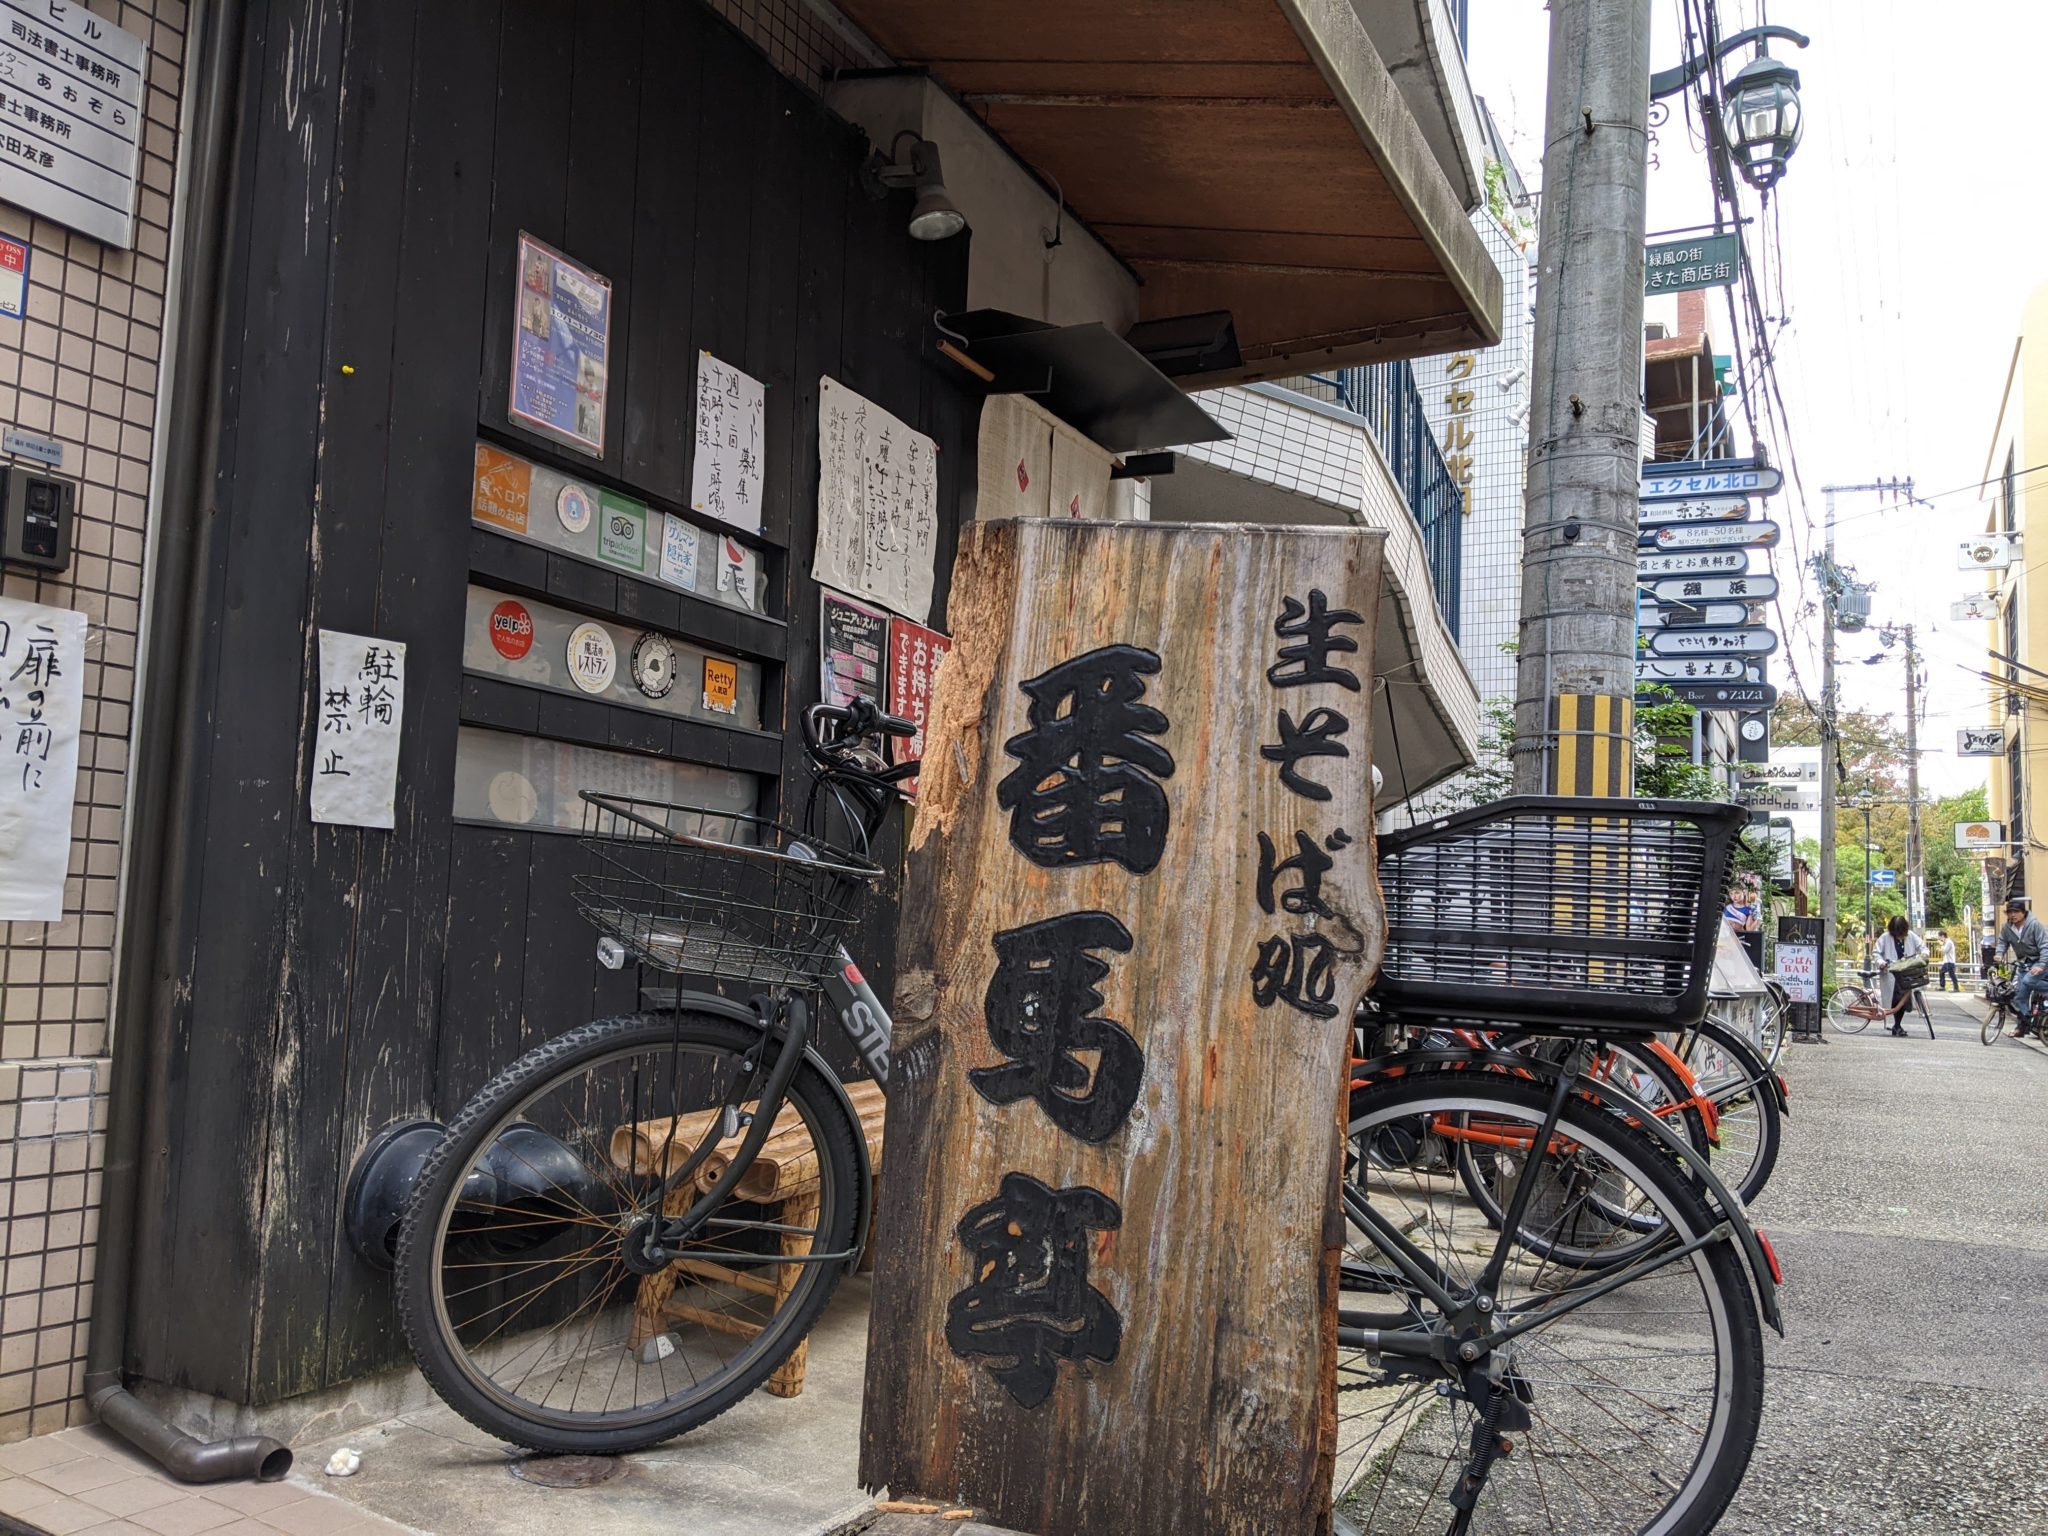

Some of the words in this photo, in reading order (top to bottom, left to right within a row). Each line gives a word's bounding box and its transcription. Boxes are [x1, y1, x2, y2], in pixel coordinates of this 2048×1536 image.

[11, 20, 121, 89] 司法書士事務所
[37, 72, 126, 126] あおぞら
[1649, 247, 1703, 267] 緑風の街
[1644, 262, 1731, 288] きた商店街
[736, 447, 752, 505] 募集
[1649, 473, 1759, 495] エクセル北口
[479, 475, 527, 508] 食べログ
[477, 496, 526, 526] 話題のお店
[603, 536, 640, 555] tripadvisor
[495, 615, 520, 634] yelp
[583, 641, 604, 658] 魔法の
[578, 654, 609, 676] レストラン
[707, 668, 734, 689] Retty
[896, 632, 910, 717] できます
[357, 646, 399, 725] 駐輪
[1729, 689, 1764, 700] zaza
[10, 625, 62, 792] 扉の前に
[908, 636, 928, 785] お持ち帰
[320, 687, 352, 777] 禁止
[1250, 587, 1365, 1020] 生そば処
[1784, 964, 1809, 973] BAR
